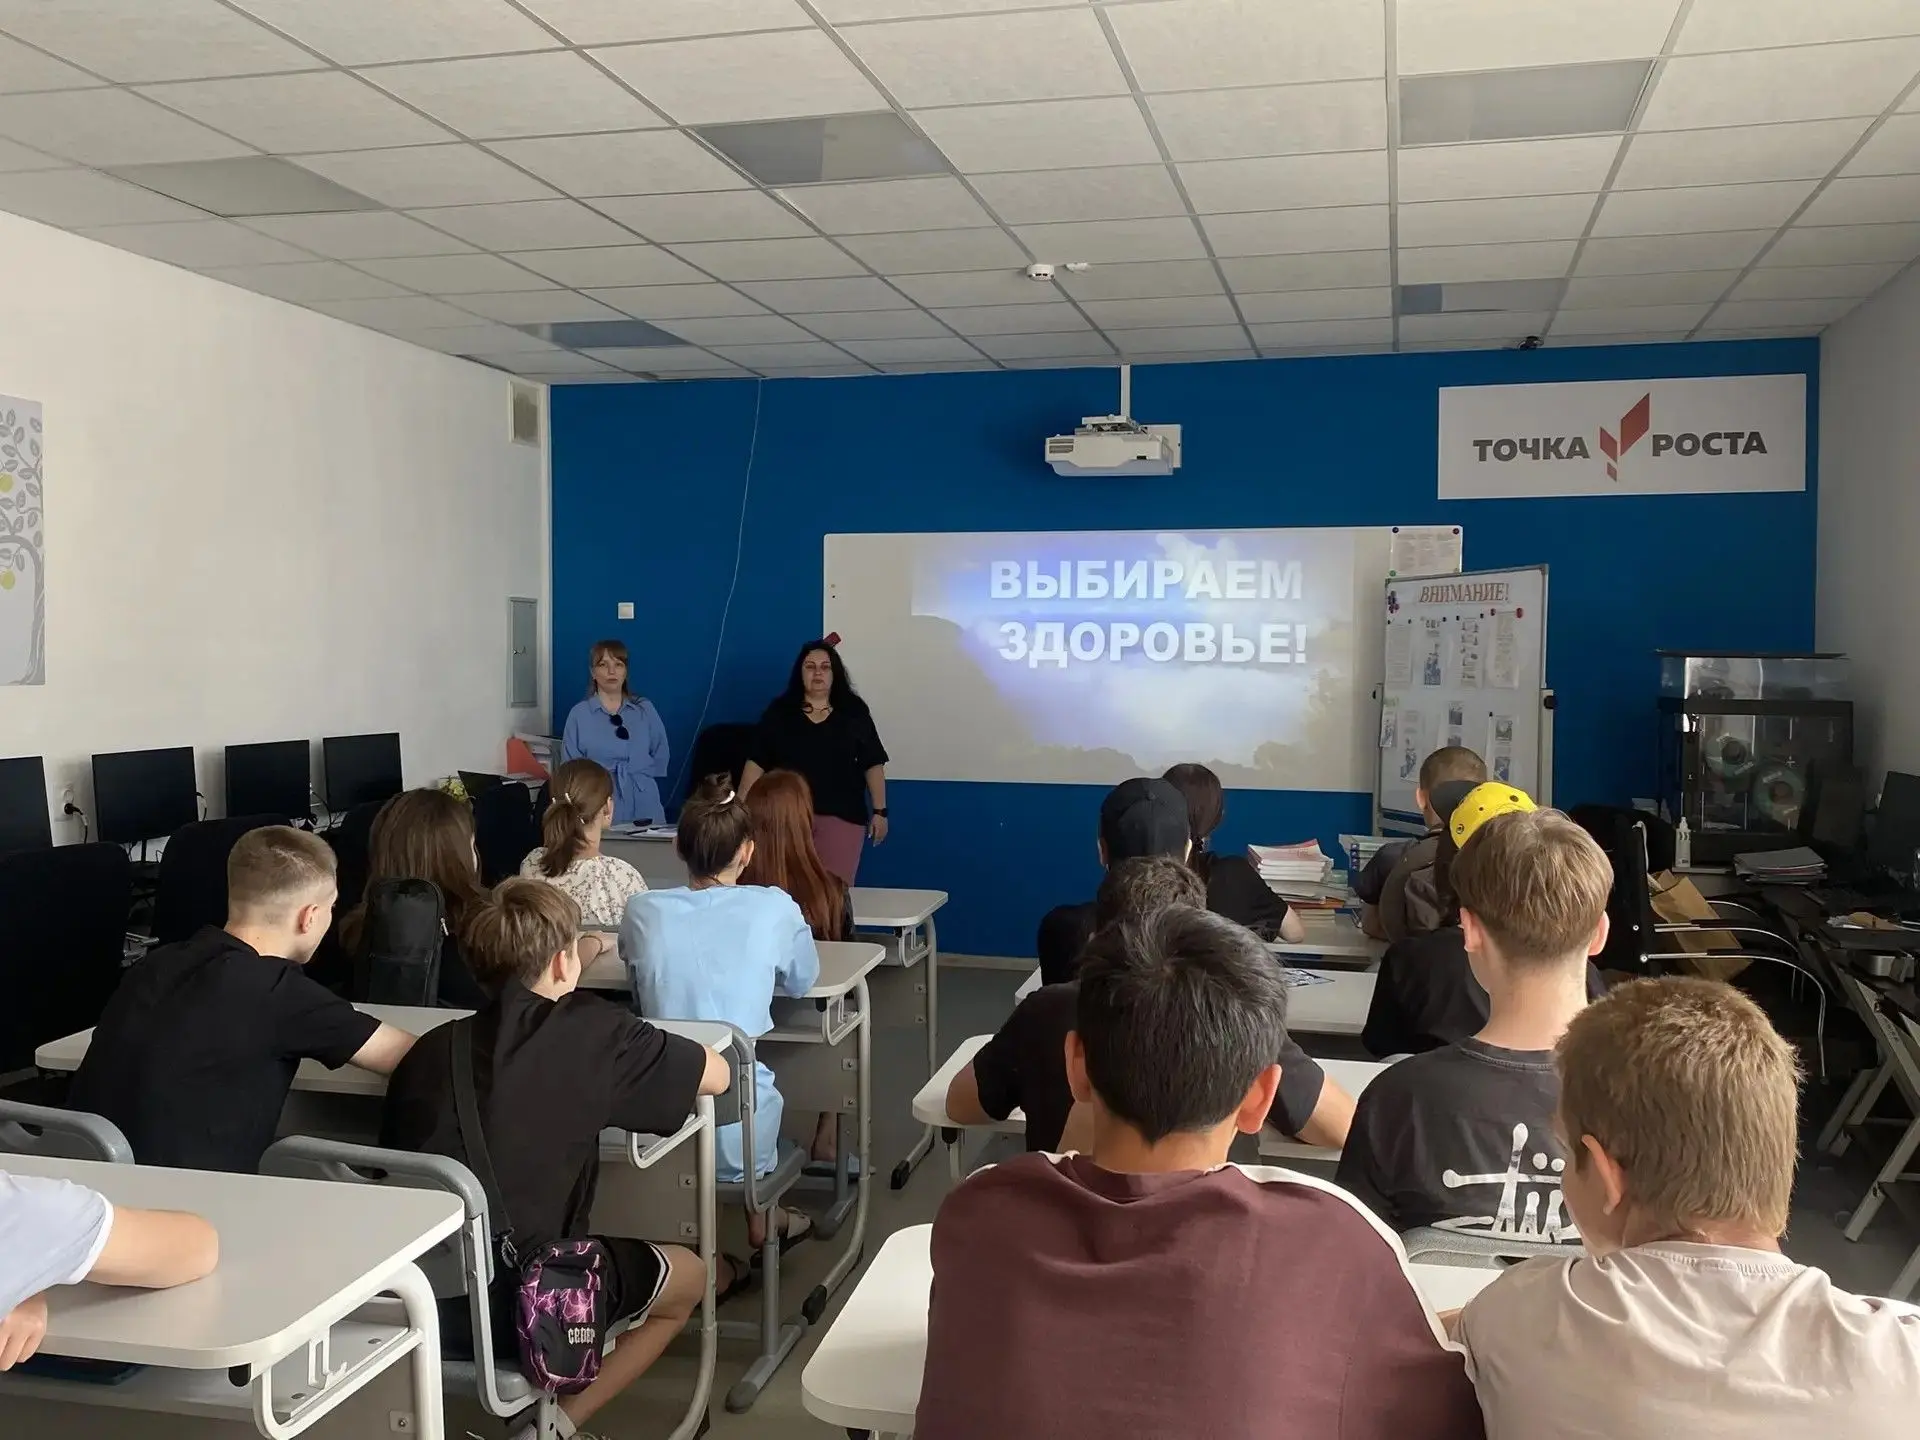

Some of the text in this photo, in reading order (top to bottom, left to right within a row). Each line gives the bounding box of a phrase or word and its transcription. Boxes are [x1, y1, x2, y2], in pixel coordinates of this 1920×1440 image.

[1472, 431, 1768, 462] ТОЧКА РОСТА
[990, 560, 1303, 600] ВЫБИРАЕМ
[1419, 582, 1510, 604] ВНИМАНИЕ!
[999, 621, 1308, 669] ЗДОРОВЬЕ!
